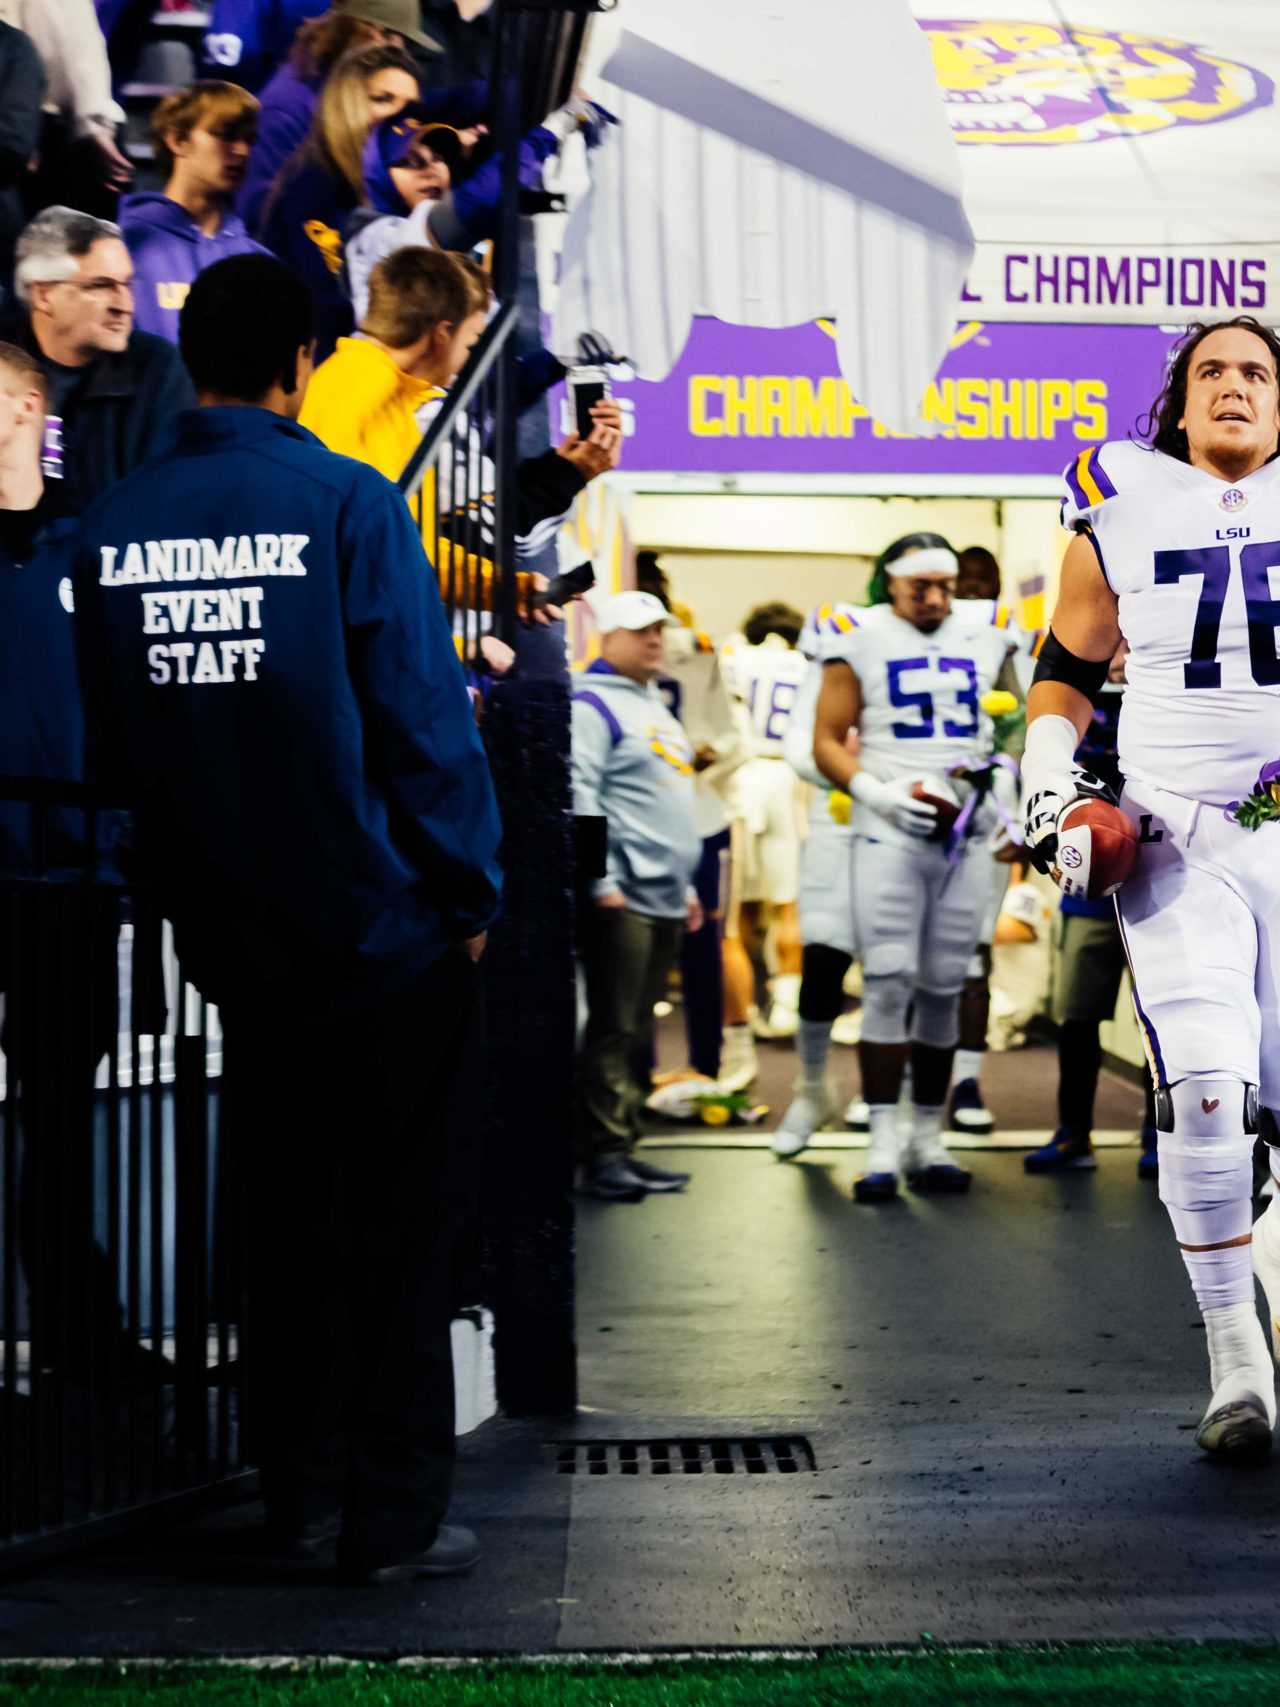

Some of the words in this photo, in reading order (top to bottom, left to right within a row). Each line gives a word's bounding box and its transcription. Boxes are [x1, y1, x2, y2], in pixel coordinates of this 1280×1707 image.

[1005, 254, 1267, 308] CHAMPIONS
[689, 375, 1108, 441] CHAMPNSHIPS
[99, 534, 310, 587] LANDMARK
[1215, 527, 1251, 541] LSU
[141, 586, 265, 635] EVENT
[148, 638, 266, 685] STAFF
[887, 656, 979, 739] 53
